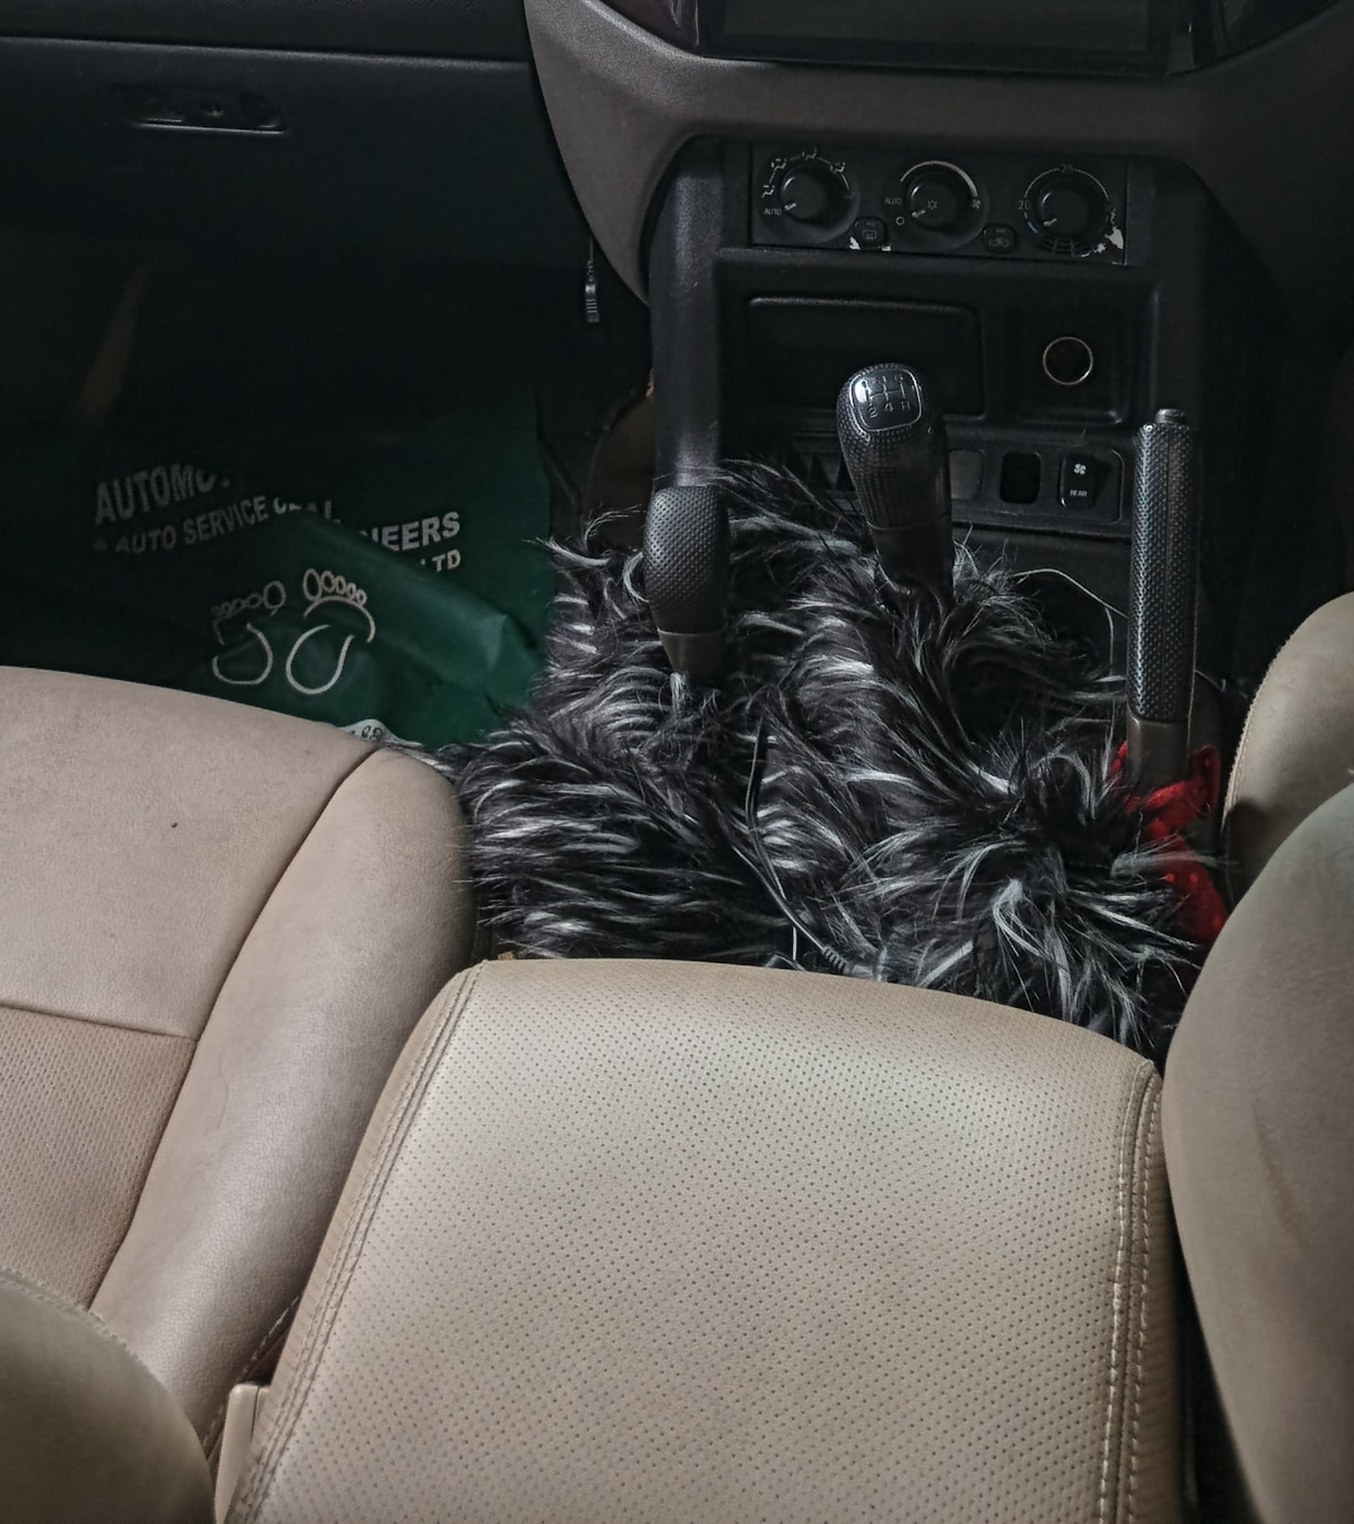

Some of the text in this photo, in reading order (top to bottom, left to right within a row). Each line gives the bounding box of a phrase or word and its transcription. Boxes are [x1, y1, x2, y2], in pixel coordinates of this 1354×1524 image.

[1060, 163, 1075, 174] 25
[884, 197, 903, 205] AUTO
[1017, 200, 1032, 211] 20
[763, 207, 783, 216] AUTO
[883, 401, 895, 413] 4
[115, 525, 179, 555] AUTO
[182, 495, 270, 546] SERVICE
